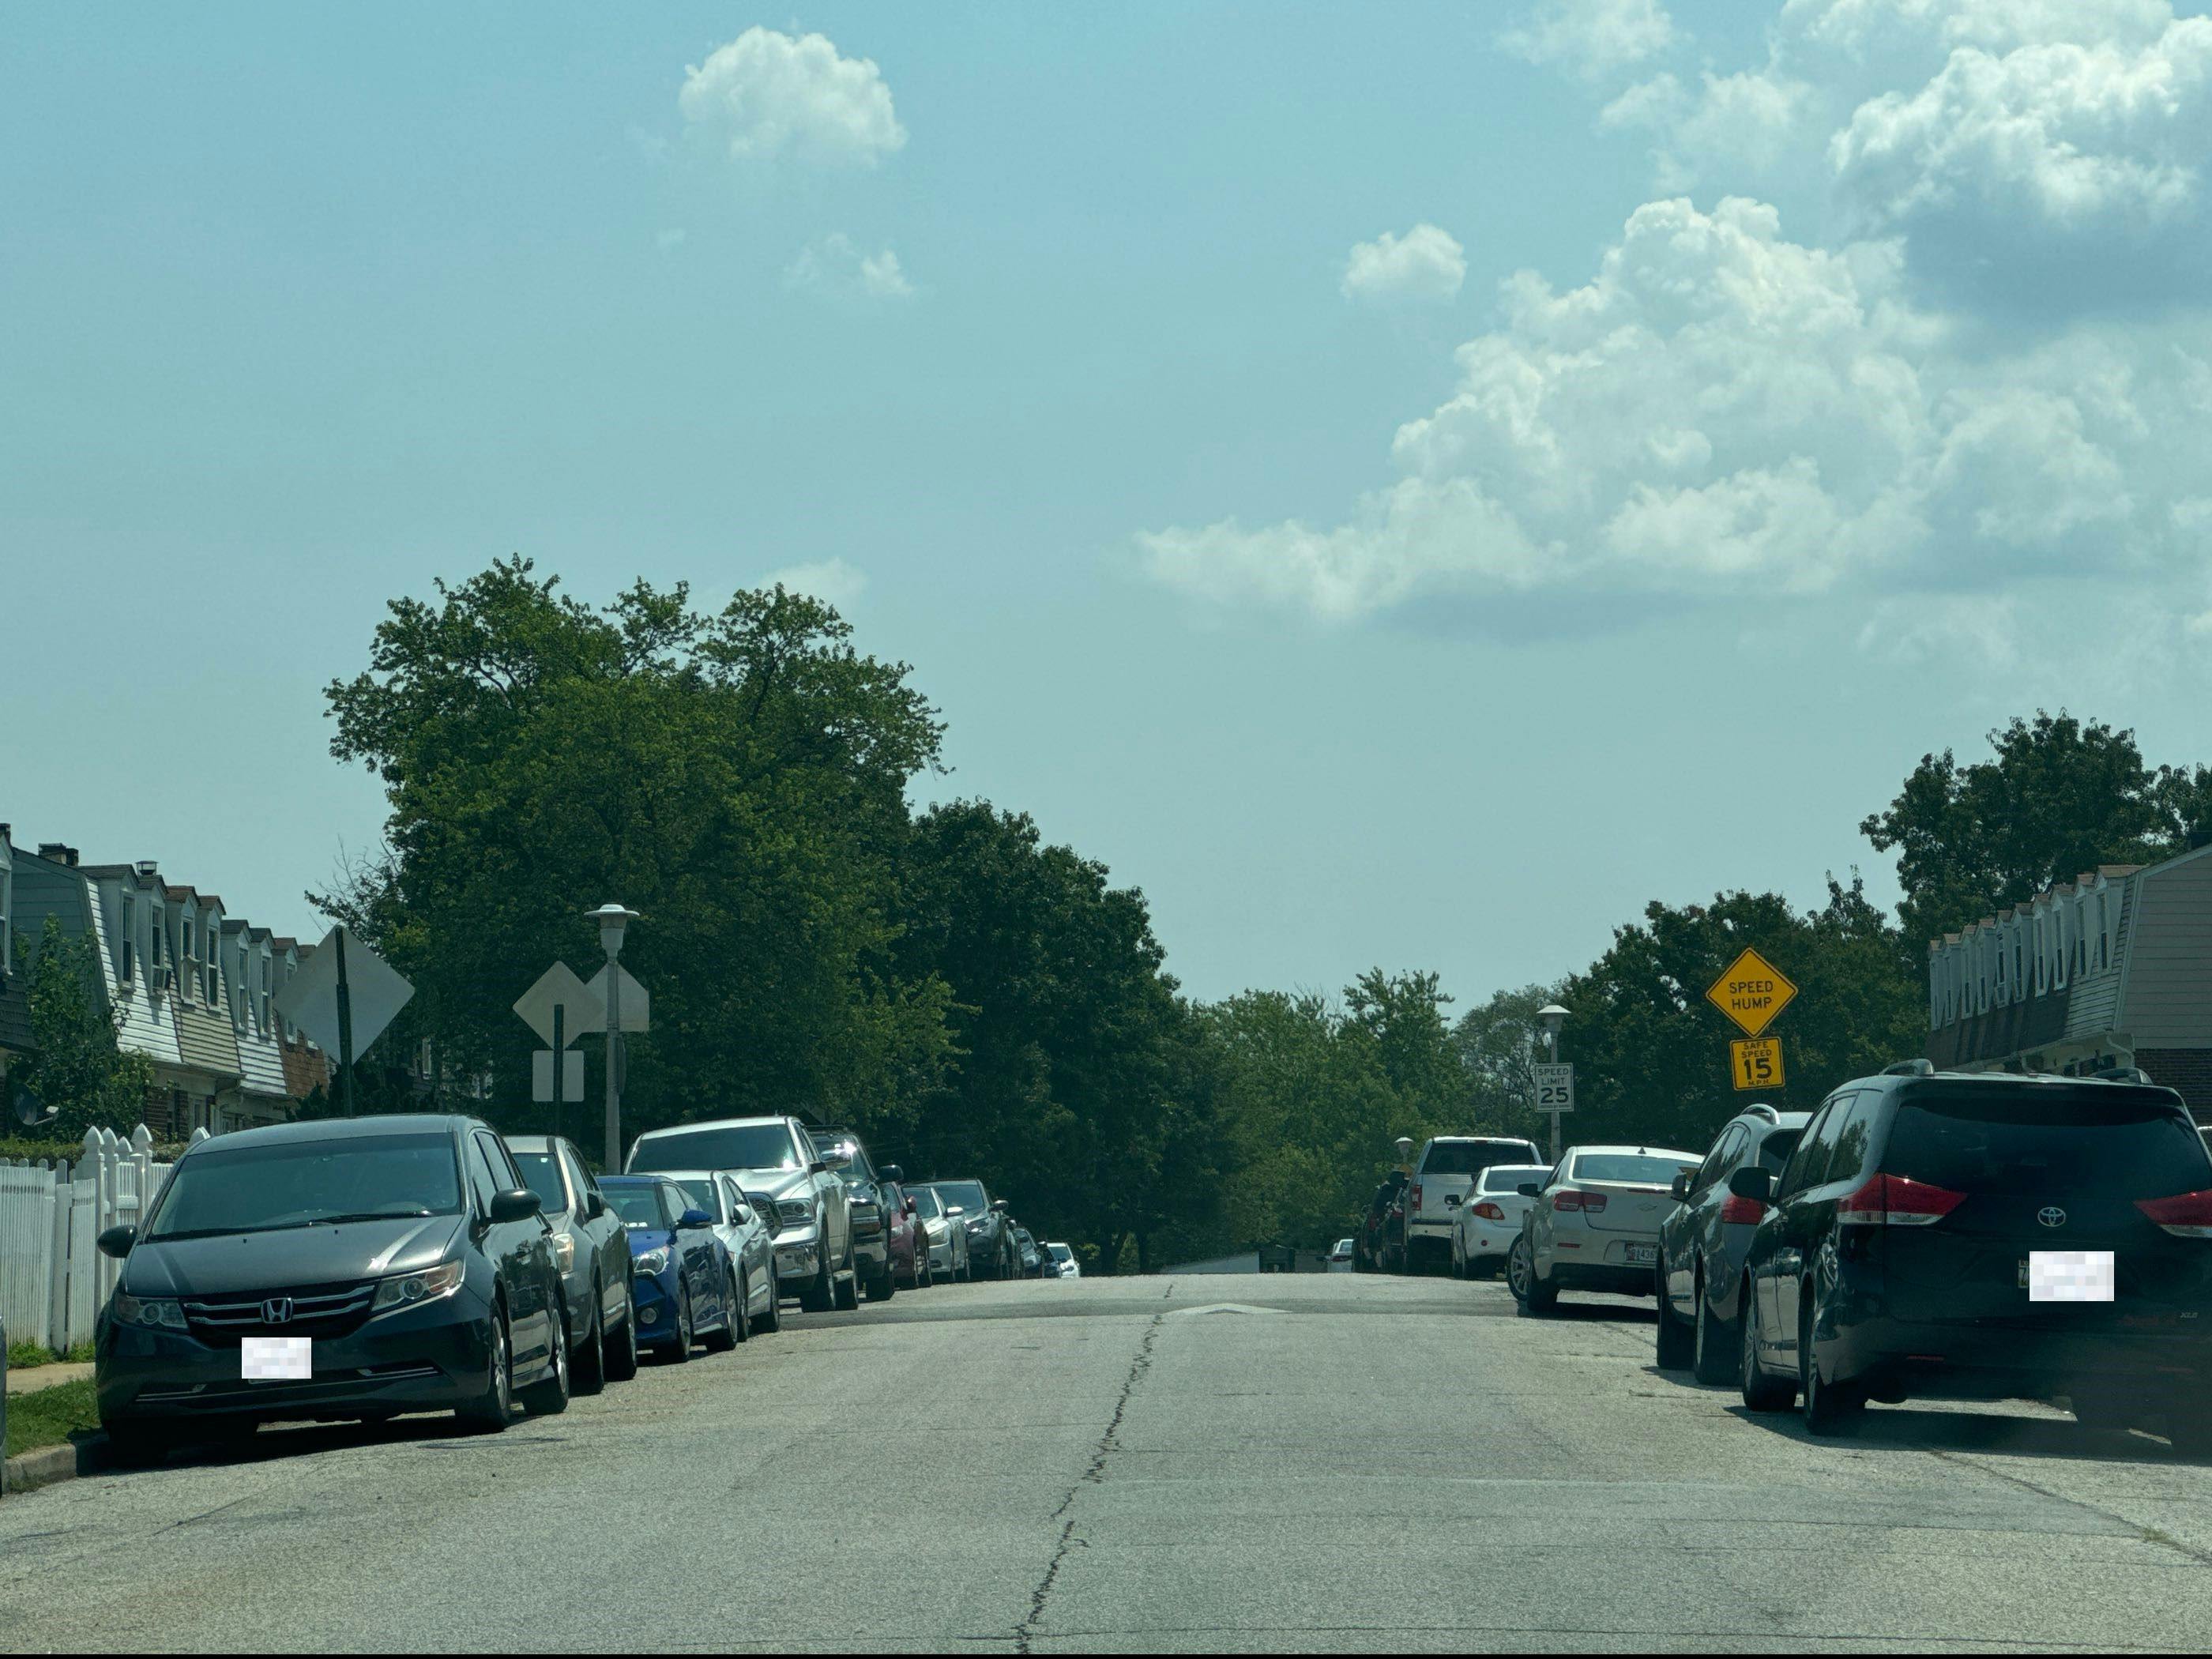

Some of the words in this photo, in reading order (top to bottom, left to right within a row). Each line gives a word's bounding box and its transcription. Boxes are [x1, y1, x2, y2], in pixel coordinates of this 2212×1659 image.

[1729, 980, 1774, 994] SPEED
[1732, 996, 1772, 1010] HUMP
[1744, 1041, 1769, 1050] SAFE
[1741, 1049, 1772, 1059] SPEED
[1537, 1067, 1569, 1076] SPEED
[1744, 1058, 1772, 1080] 15
[1540, 1087, 1569, 1104] 25
